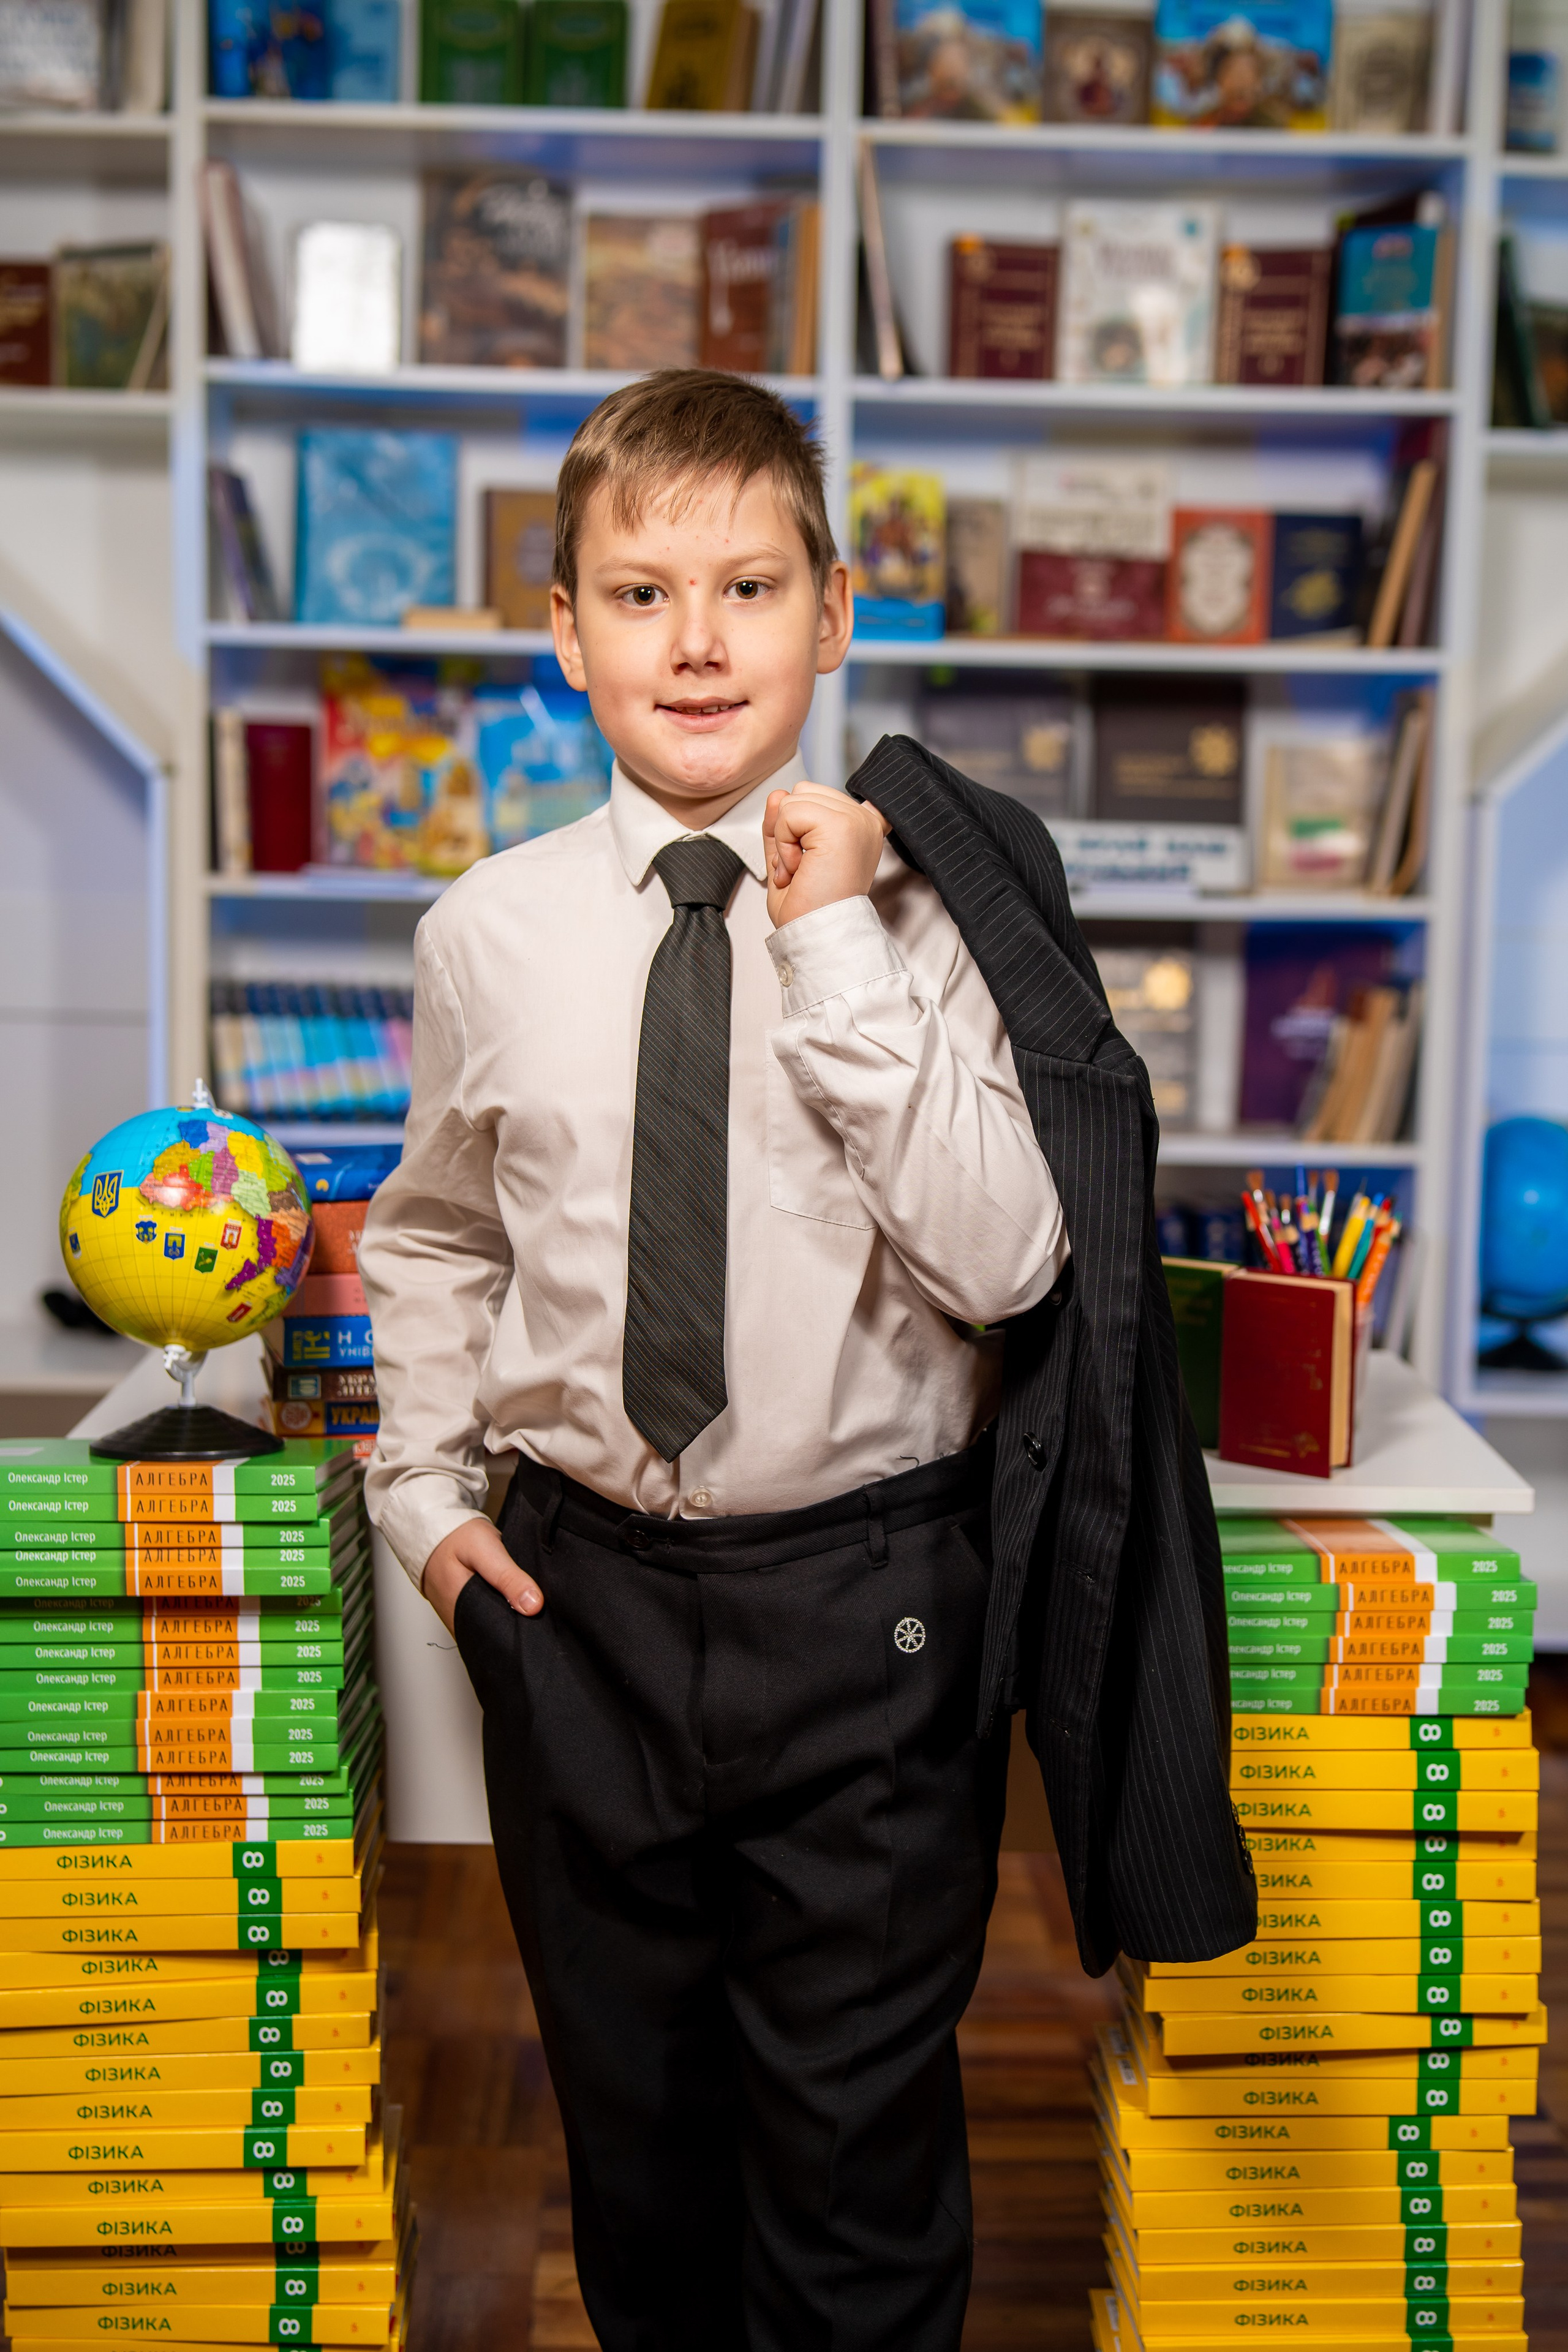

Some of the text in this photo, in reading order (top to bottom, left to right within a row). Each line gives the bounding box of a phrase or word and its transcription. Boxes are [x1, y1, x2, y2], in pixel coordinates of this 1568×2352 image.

[7, 1472, 295, 1486] Олександр Істер АЛГЕБРА 2025
[8, 1499, 296, 1513] Олександр Істер АЛГЕБРА 2025
[14, 1530, 304, 1544] Олександр Істер АЛГЕБРА 2025
[15, 1548, 304, 1563] Олександр Істер АЛГЕБРА 2025
[1223, 1564, 1267, 1575] лександр
[1339, 1560, 1411, 1574] АЛГЕБРА
[1473, 1560, 1498, 1572] 2025
[15, 1575, 305, 1589] Олександр Істер АЛГЕБРА 2025
[161, 1596, 234, 1609] АЛГЕБРА
[1357, 1589, 1430, 1603] АЛГЕБРА
[1492, 1589, 1517, 1602] 2025
[33, 1619, 320, 1634] Олександр Істер АЛГЕБРА 2025
[1354, 1616, 1426, 1629] АЛГЕБРА
[1488, 1617, 1513, 1629] 2025
[34, 1645, 321, 1660] Олександр Істер АЛГЕБРА 2025
[1229, 1645, 1275, 1656] лександр
[1347, 1642, 1420, 1656] АЛГЕБРА
[1483, 1643, 1507, 1654] 2025
[36, 1670, 322, 1685] Олександр Істер АЛГЕБРА 2025
[1230, 1670, 1270, 1680] ександр
[1342, 1668, 1415, 1681] АЛГЕБРА
[1478, 1669, 1502, 1681] 2025
[28, 1698, 315, 1714] Олександр Істер АЛГЕБРА 2025
[1231, 1700, 1265, 1710] ксандр
[1338, 1698, 1411, 1711] АЛГЕБРА
[1474, 1700, 1499, 1711] 2025
[27, 1728, 313, 1743] Олександр Істер АЛГЕБРА 2025
[1233, 1726, 1308, 1741] ФІЗИКА
[29, 1751, 314, 1765] Олександр Істер АЛГЕБРА 2025
[1239, 1765, 1315, 1779] ФІЗИКА
[39, 1774, 324, 1788] Олександр Істер АЛГЕБРА 2025
[43, 1798, 329, 1814] Олександр Істер АЛГЕБРА 2025
[1235, 1802, 1311, 1817] ФІЗИКА
[43, 1823, 328, 1840] Олександр Істер АЛГЕБРА 2025
[56, 1855, 132, 1869] ФІЗИКА
[62, 1892, 138, 1907] ФІЗИКА
[62, 1929, 138, 1943] ФІЗИКА
[1245, 1951, 1321, 1966] ФІЗИКА
[81, 1958, 159, 1975] ФІЗИКА
[1242, 1988, 1317, 2002] ФІЗИКА
[79, 1998, 156, 2015] ФІЗИКА
[73, 2032, 149, 2048] ФІЗИКА
[1259, 2025, 1333, 2041] ФІЗИКА
[1243, 2052, 1320, 2066] ФІЗИКА
[85, 2067, 161, 2082] ФІЗИКА
[1243, 2091, 1318, 2105] ФІЗИКА
[77, 2105, 153, 2119] ФІЗИКА
[1215, 2125, 1290, 2139] ФІЗИКА
[68, 2145, 144, 2160] ФІЗИКА
[1226, 2166, 1300, 2180] ФІЗИКА
[88, 2179, 164, 2195] ФІЗИКА
[1229, 2203, 1303, 2217] ФІЗИКА
[96, 2221, 173, 2236] ФІЗИКА
[100, 2245, 177, 2258] ФІЗИКА
[1234, 2241, 1307, 2254] ФІЗИКА
[102, 2282, 177, 2296] ФІЗИКА
[1234, 2279, 1307, 2291] ФІЗИКА
[97, 2316, 172, 2331] ФІЗИКА
[1234, 2313, 1308, 2326] ФІЗИКА
